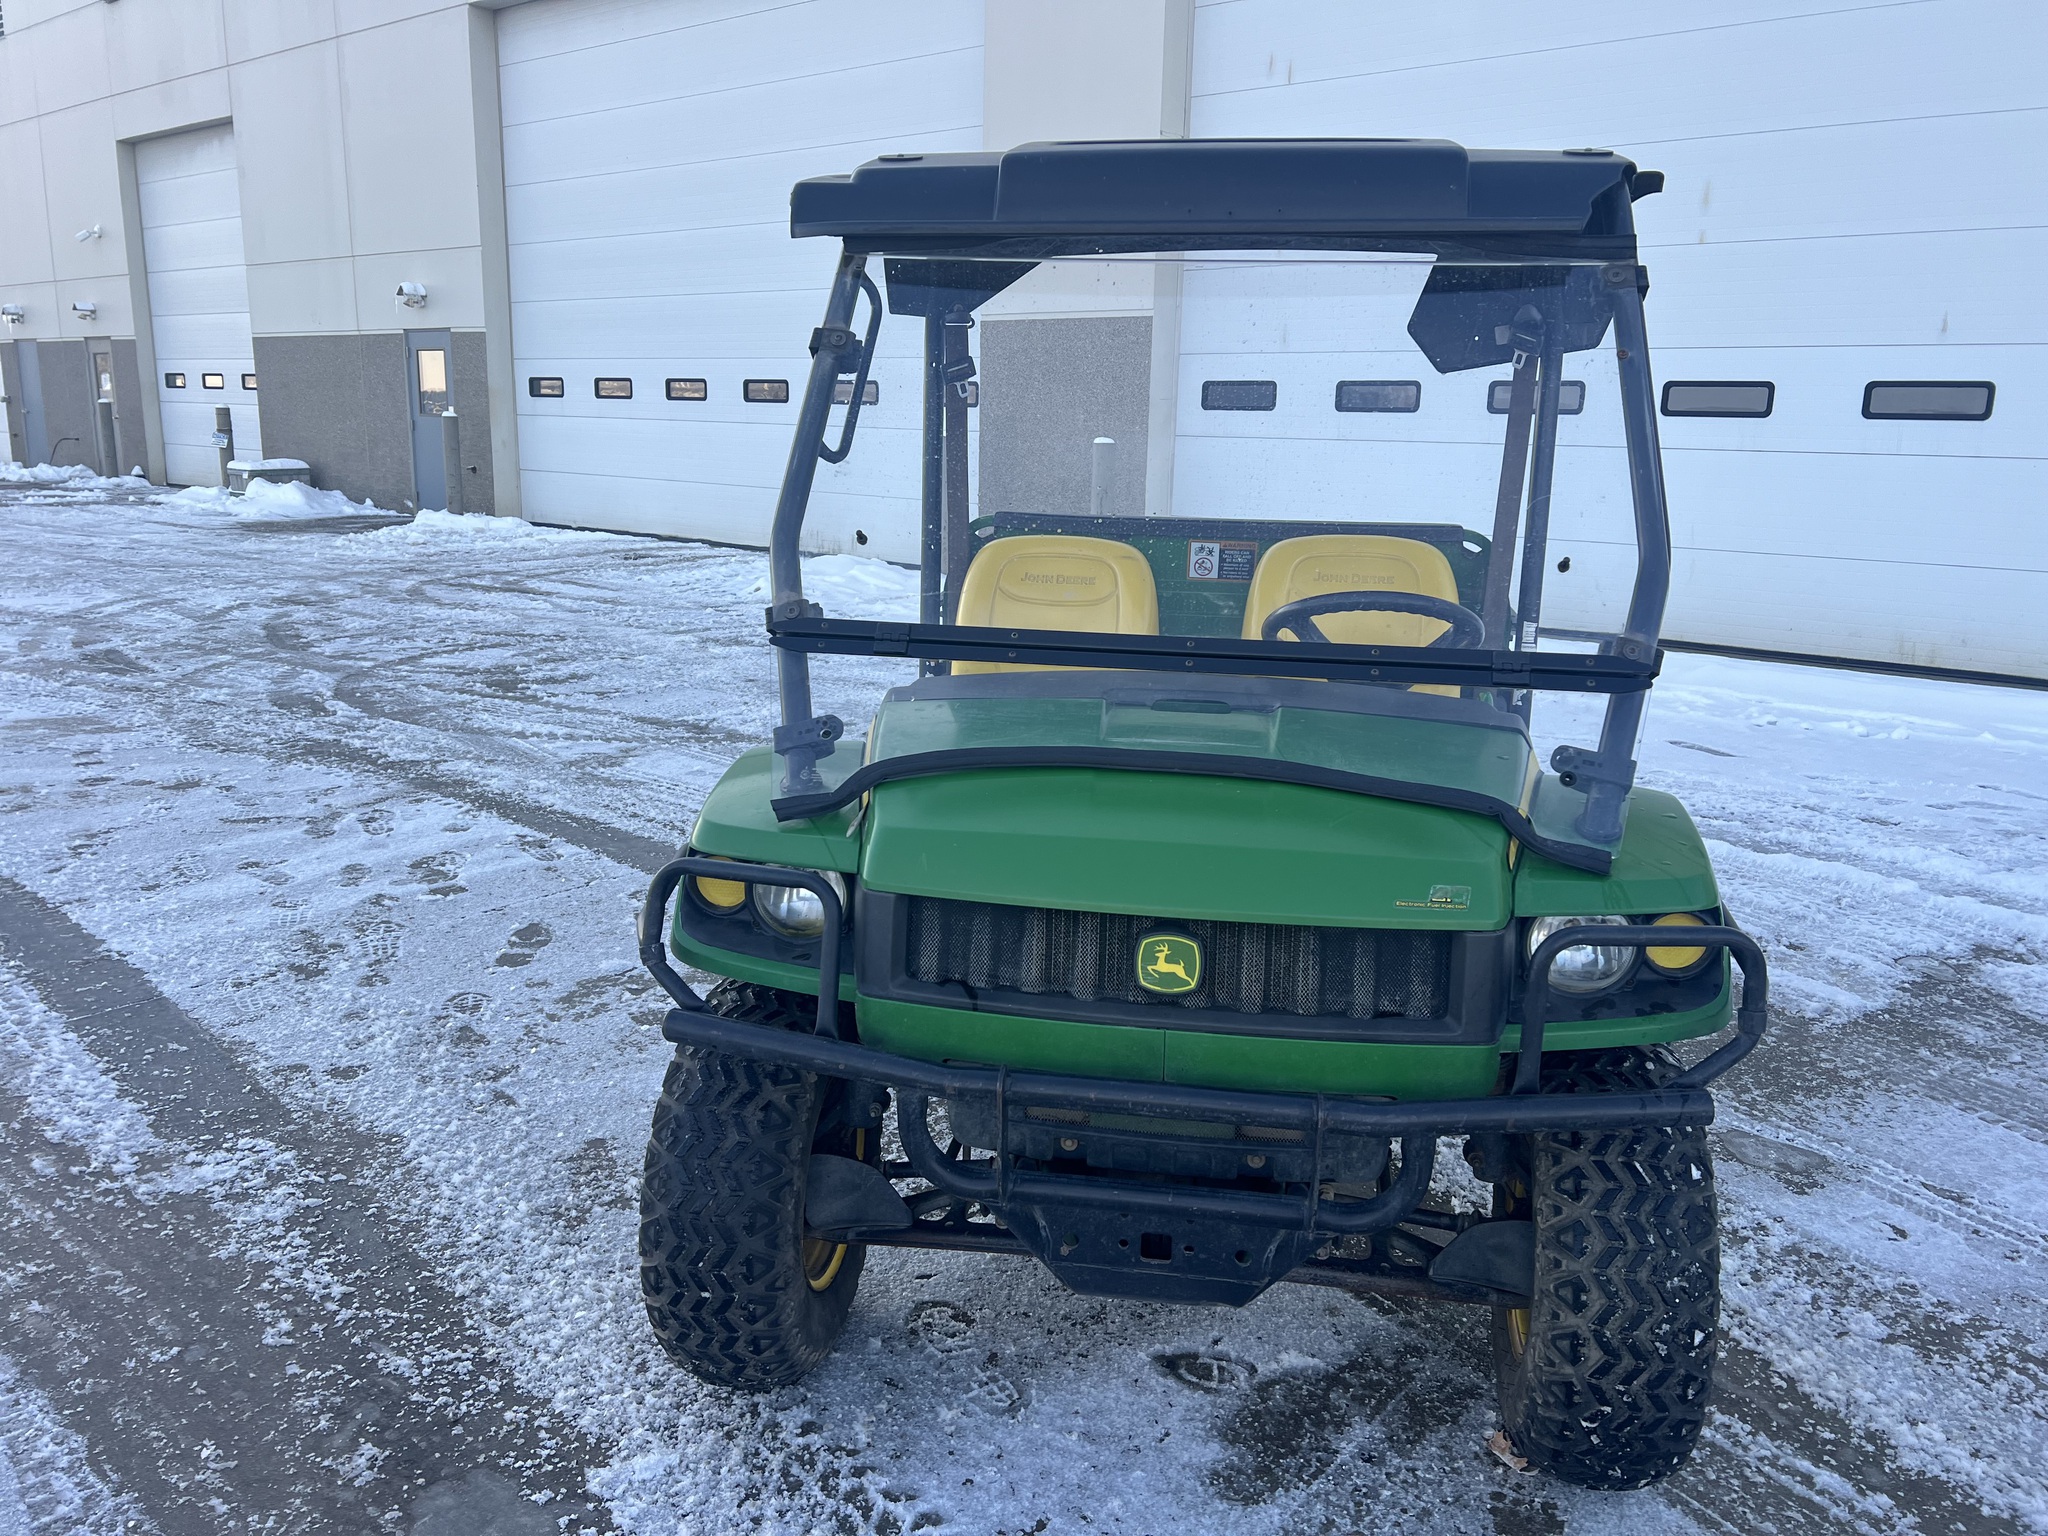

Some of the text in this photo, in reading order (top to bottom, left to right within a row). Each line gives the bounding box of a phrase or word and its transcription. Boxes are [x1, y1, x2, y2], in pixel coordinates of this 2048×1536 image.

[1020, 571, 1097, 585] JOHN DEERE
[1313, 570, 1395, 585] JOHN DEERE
